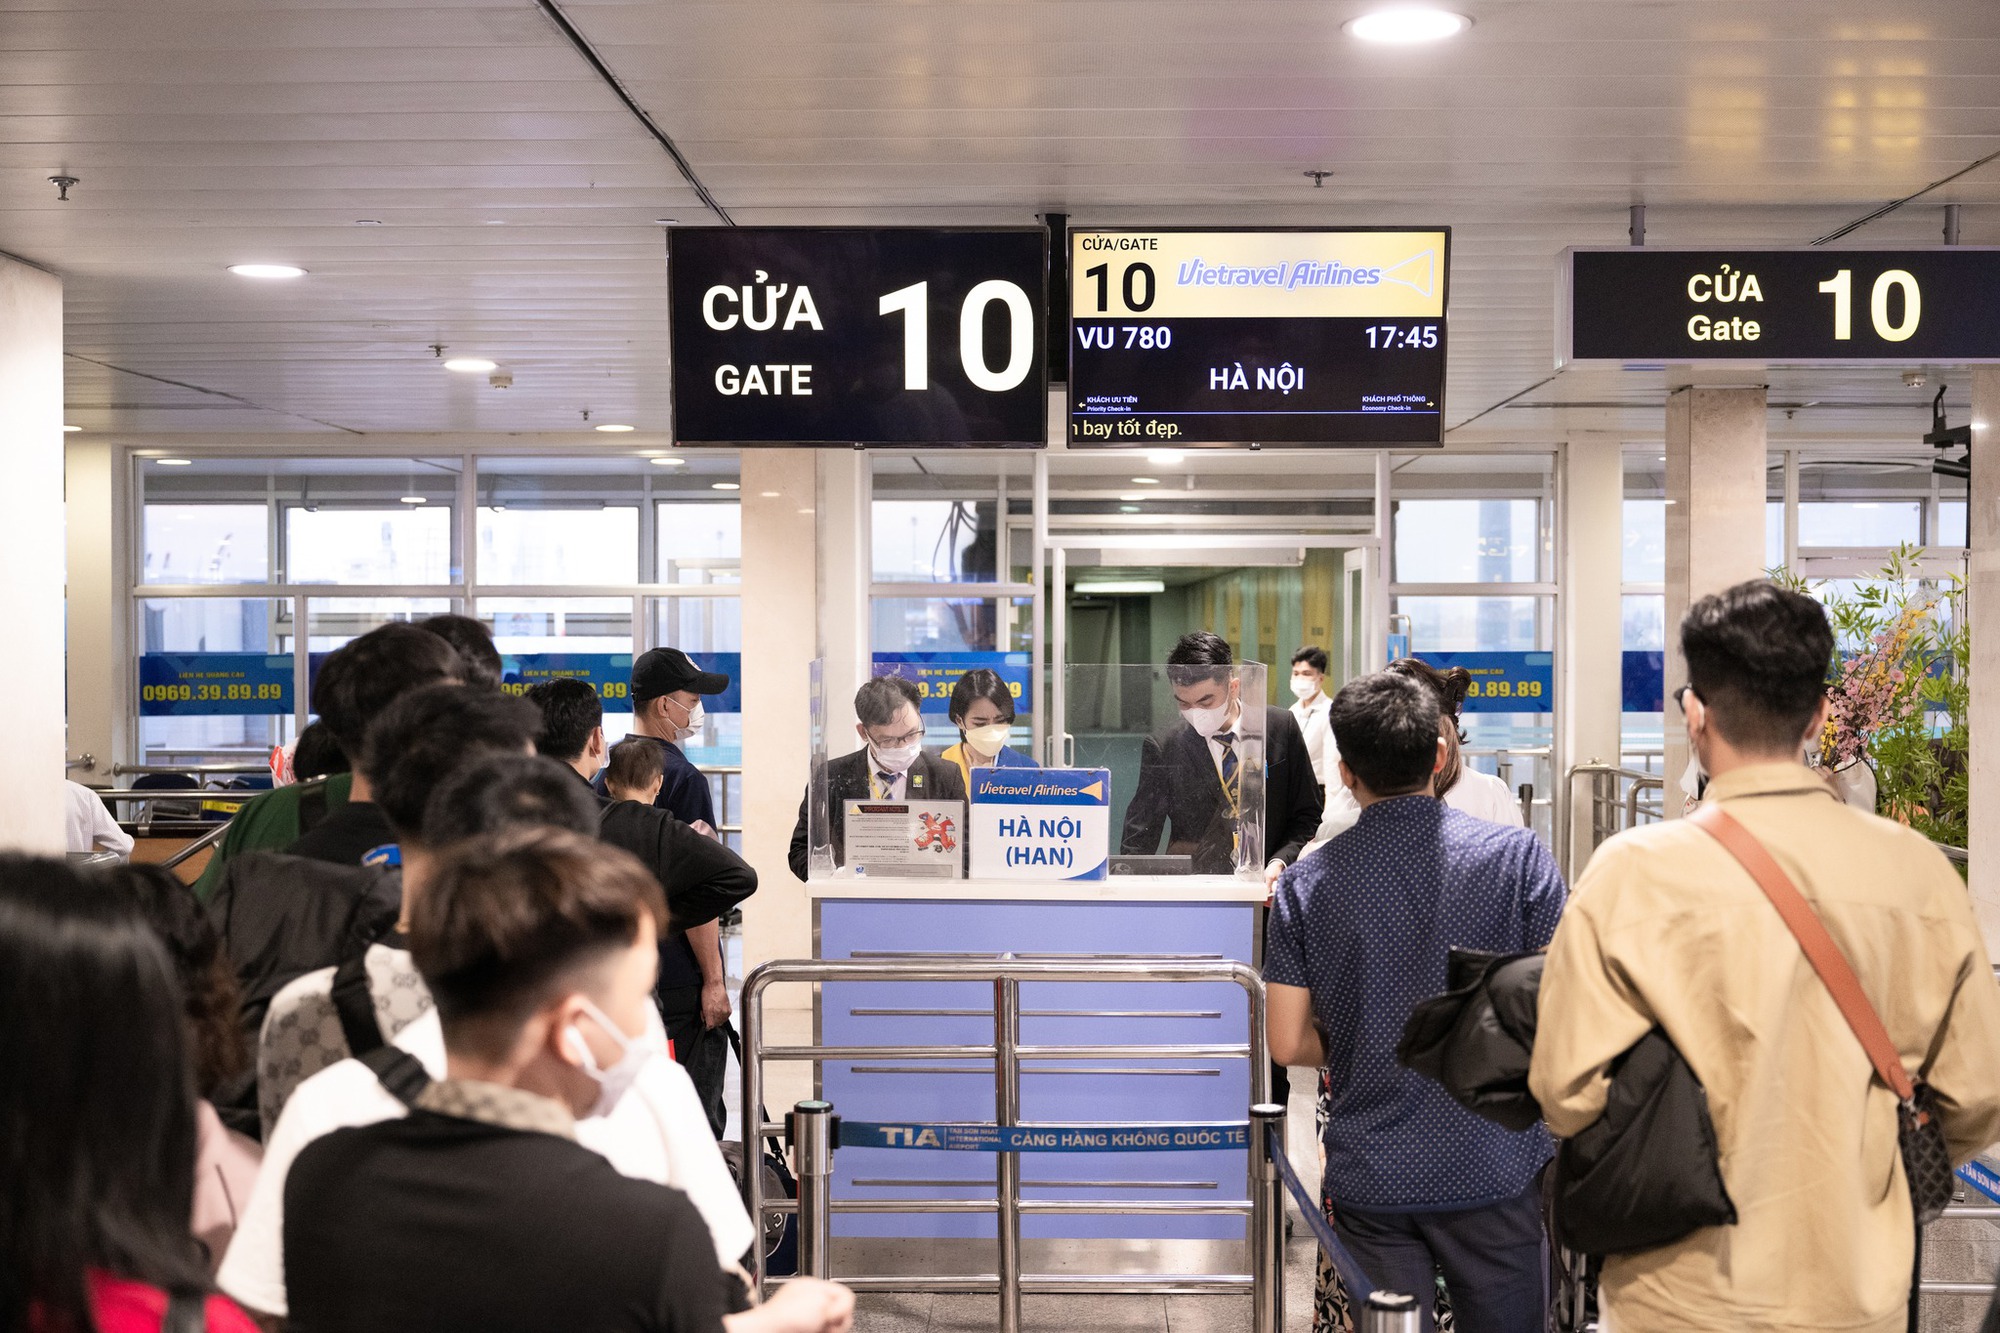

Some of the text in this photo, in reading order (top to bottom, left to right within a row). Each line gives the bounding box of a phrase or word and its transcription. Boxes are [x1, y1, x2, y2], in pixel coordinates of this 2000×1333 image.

[1082, 235, 1158, 251] CỬA/GATE
[1177, 257, 1381, 291] Vietravel Airlines
[1687, 264, 1764, 303] CỬA
[1086, 262, 1156, 312] 10
[702, 270, 824, 331] CỬA
[1818, 269, 1921, 342] 10
[878, 279, 1034, 392] 10
[1077, 327, 1172, 350] VU 780
[1365, 326, 1438, 349] 17:45
[1687, 315, 1761, 341] Gate
[714, 365, 813, 395] GATE
[1210, 362, 1304, 394] HÀ NỘI
[1083, 419, 1113, 439] bay
[1117, 418, 1141, 436] tốt
[1145, 419, 1182, 439] đẹp.
[142, 684, 282, 701] 0969.39.89.89
[1467, 681, 1542, 698] 9.89.89
[979, 781, 1078, 797] Vietravel Airlines
[999, 815, 1081, 843] HÀ NỘI
[1006, 846, 1073, 868] (HAN)
[879, 1126, 941, 1147] TIA
[1061, 1130, 1107, 1146] HÀNG
[1112, 1130, 1170, 1146] KHÔNG
